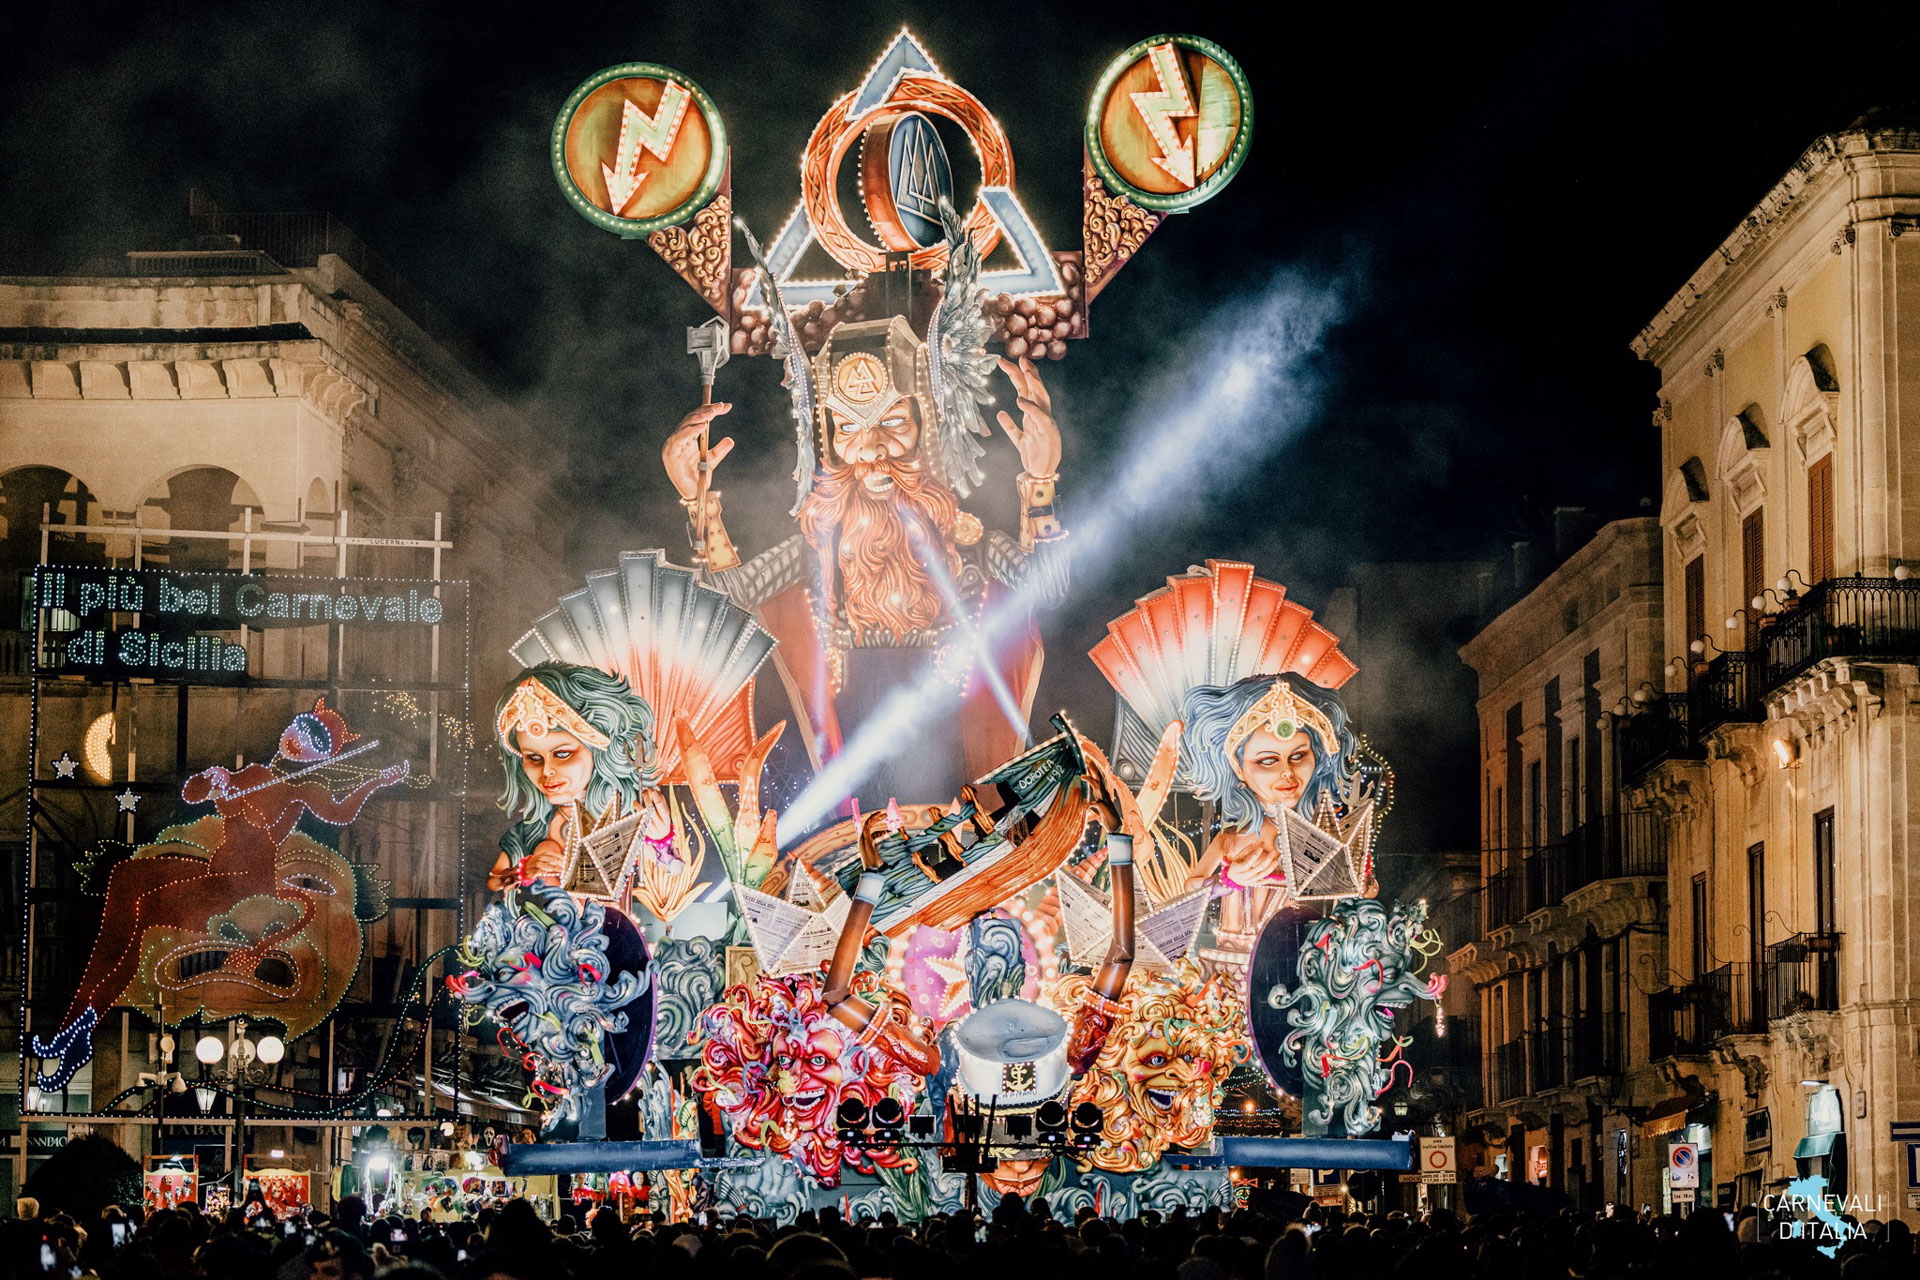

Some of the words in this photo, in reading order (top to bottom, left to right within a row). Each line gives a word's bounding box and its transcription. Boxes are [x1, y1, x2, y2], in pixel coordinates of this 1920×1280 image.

[80, 576, 143, 616] più
[159, 577, 220, 615] bel
[235, 583, 443, 624] Carnevale
[67, 630, 105, 665] di
[118, 631, 246, 671] Sicilia
[1018, 759, 1054, 789] DOROTEA
[1047, 765, 1065, 782] 492
[997, 1090, 1038, 1099] CAPITANO
